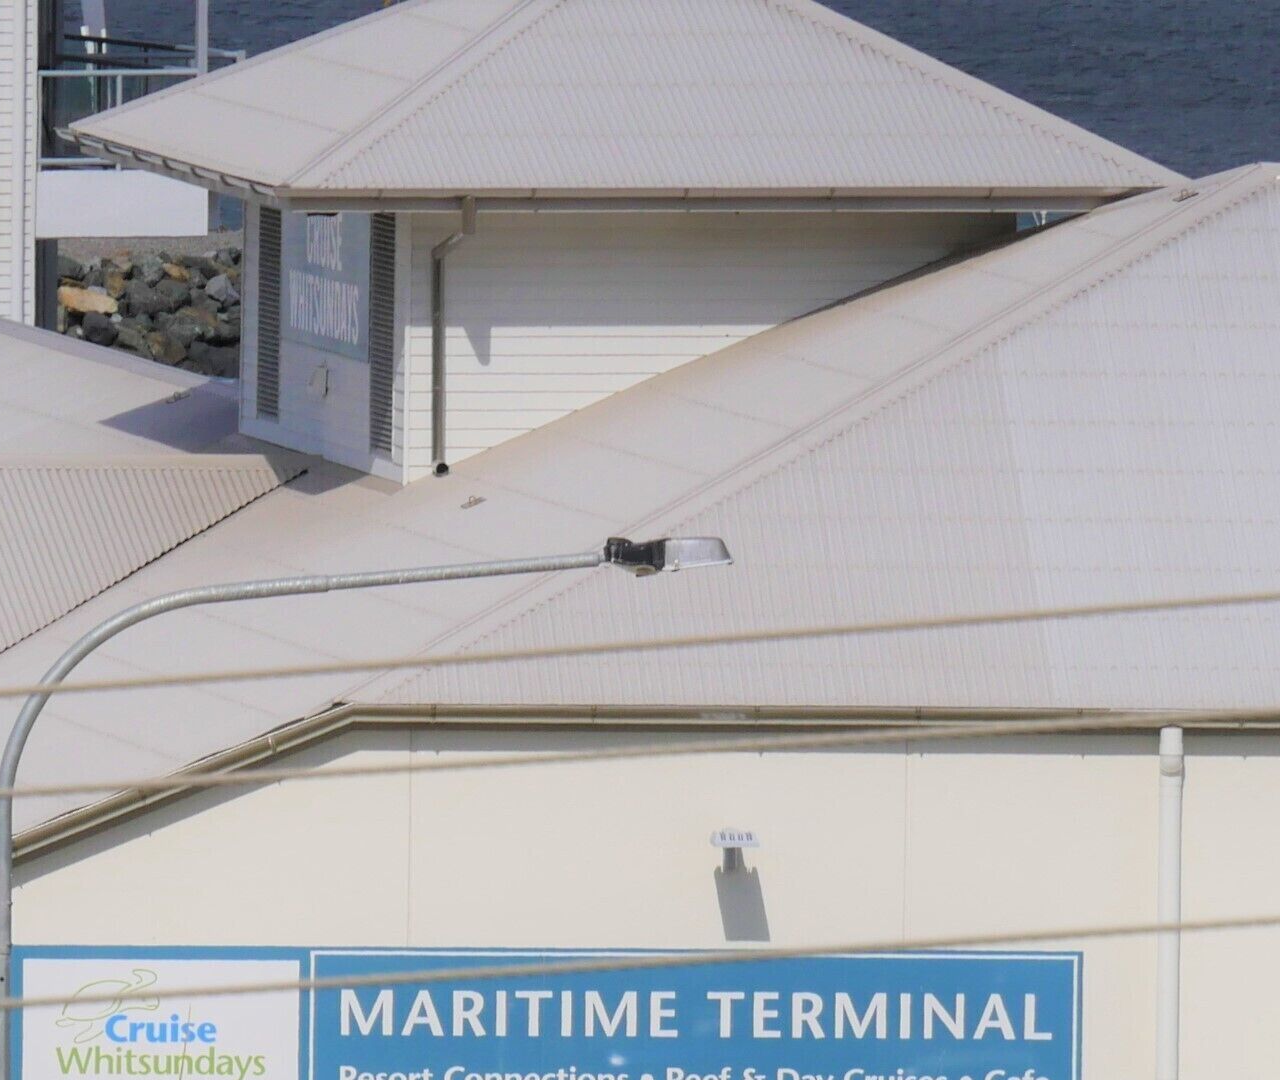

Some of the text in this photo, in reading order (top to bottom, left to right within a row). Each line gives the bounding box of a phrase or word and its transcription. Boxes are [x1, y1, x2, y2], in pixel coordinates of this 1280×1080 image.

[306, 213, 343, 272] CRUISE
[289, 268, 360, 345] WHITSUNDAYS
[105, 1013, 217, 1043] Cruise
[340, 990, 1052, 1040] MARITIME TERMINAL
